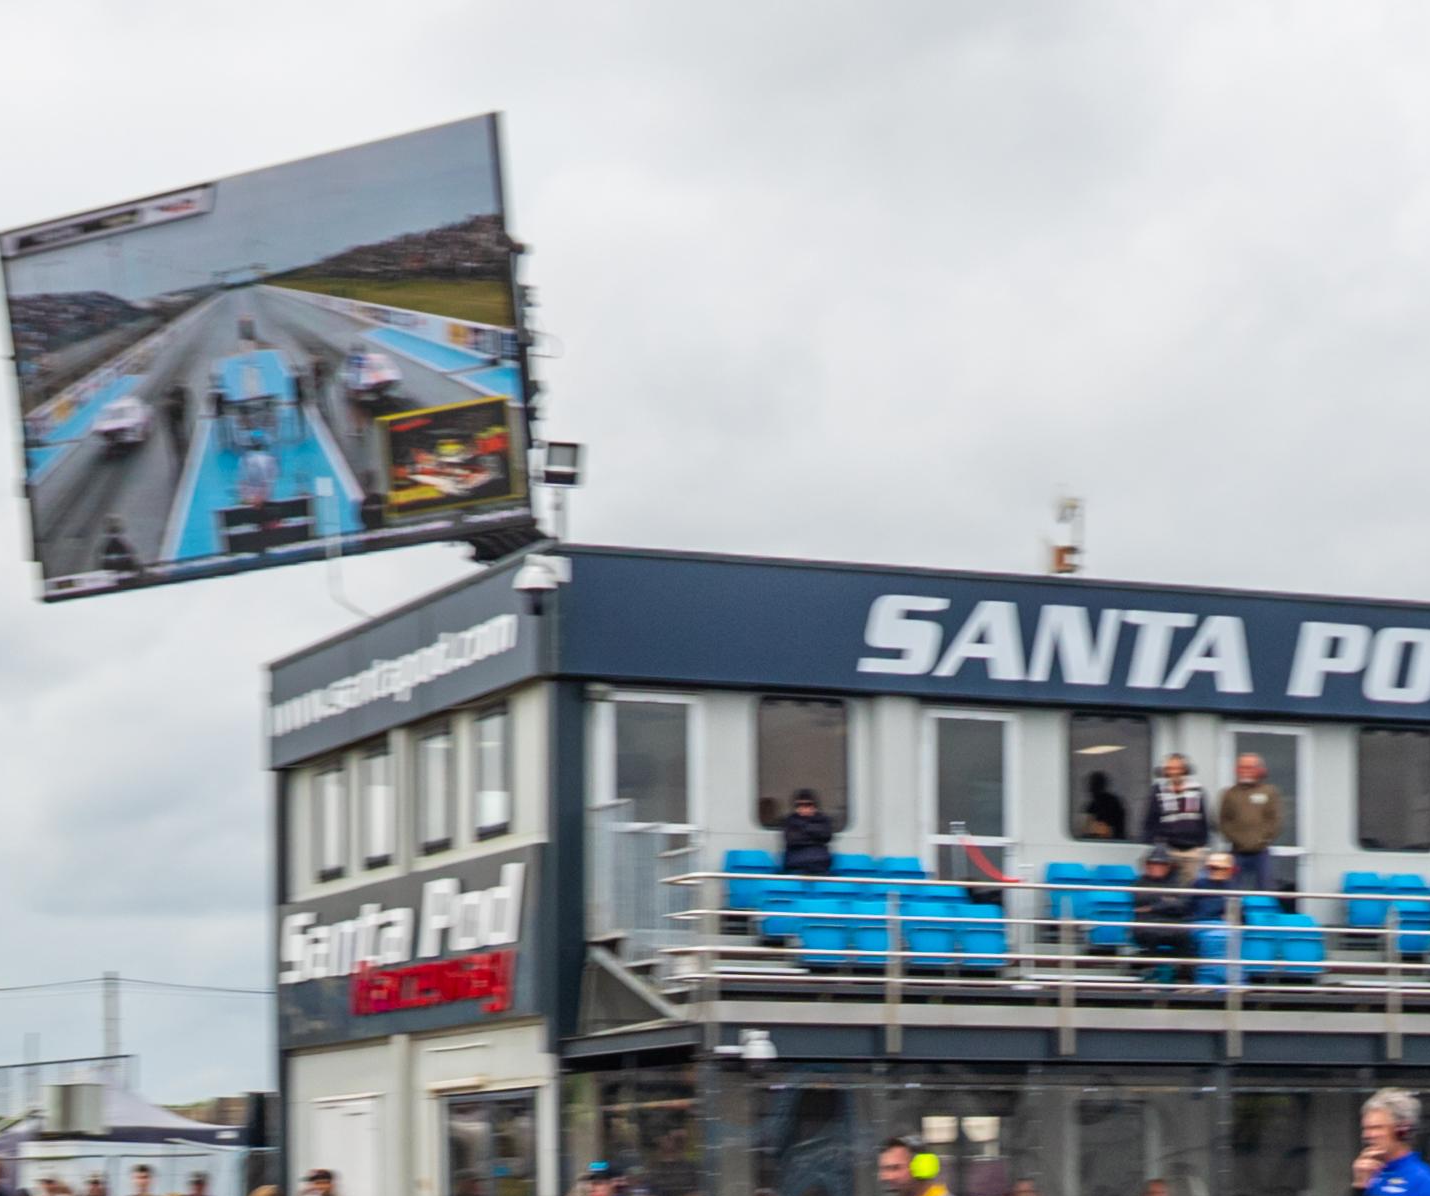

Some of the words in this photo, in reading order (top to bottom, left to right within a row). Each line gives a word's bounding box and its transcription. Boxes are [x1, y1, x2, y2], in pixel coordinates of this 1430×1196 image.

[857, 594, 1253, 693] SANTA
[280, 903, 414, 984] Santa
[417, 862, 525, 959] Pod
